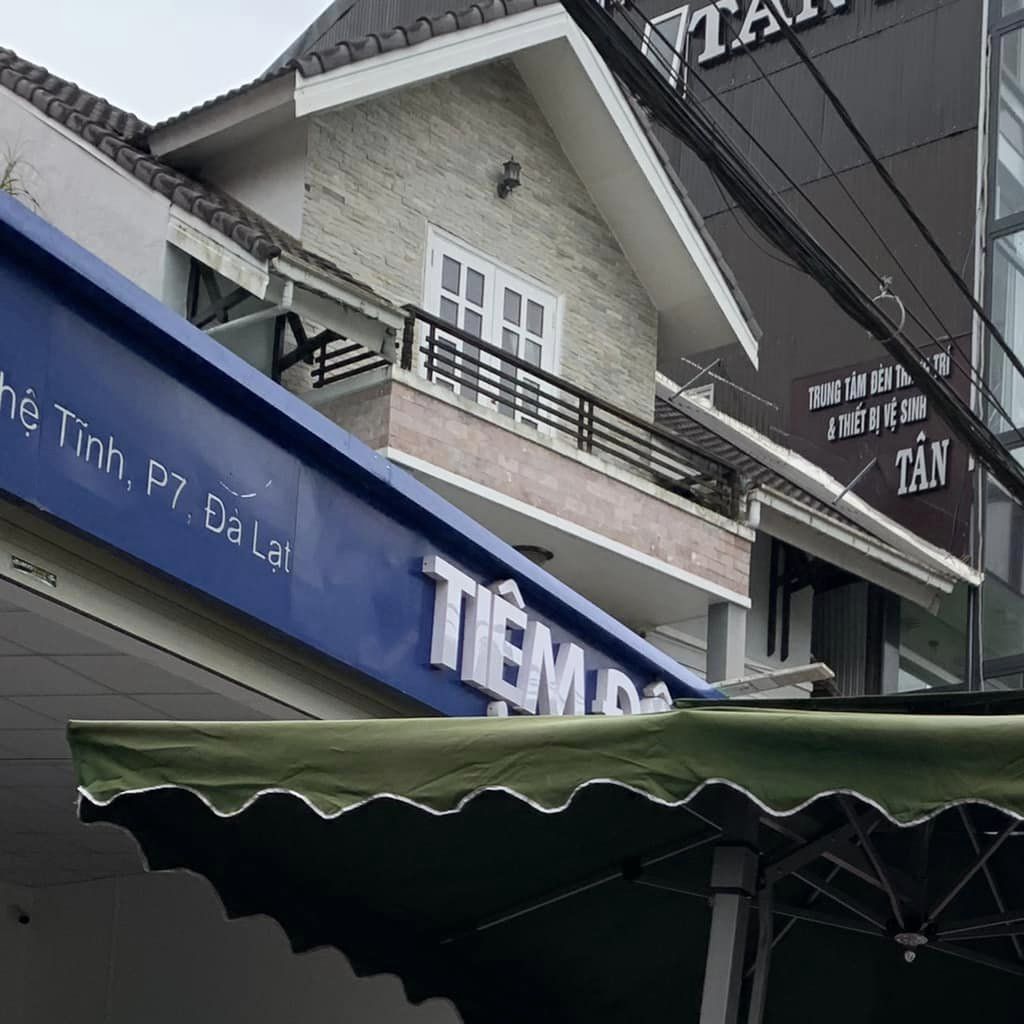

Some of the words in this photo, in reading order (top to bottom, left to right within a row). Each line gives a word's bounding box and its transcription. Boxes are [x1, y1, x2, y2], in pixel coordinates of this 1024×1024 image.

[808, 379, 842, 411] TRUNG
[845, 371, 867, 401] TÂM
[870, 363, 893, 395] ĐÈN
[827, 416, 836, 441] &
[838, 402, 866, 439] THIẾT
[868, 405, 880, 435] BỊ
[884, 397, 898, 432] VỆ
[901, 395, 928, 424] SINH
[54, 404, 132, 491] Tĩnh,
[205, 493, 242, 545] Đà
[252, 520, 291, 573] Lạt
[895, 430, 950, 496] TÂN
[422, 555, 584, 716] TIỆM
